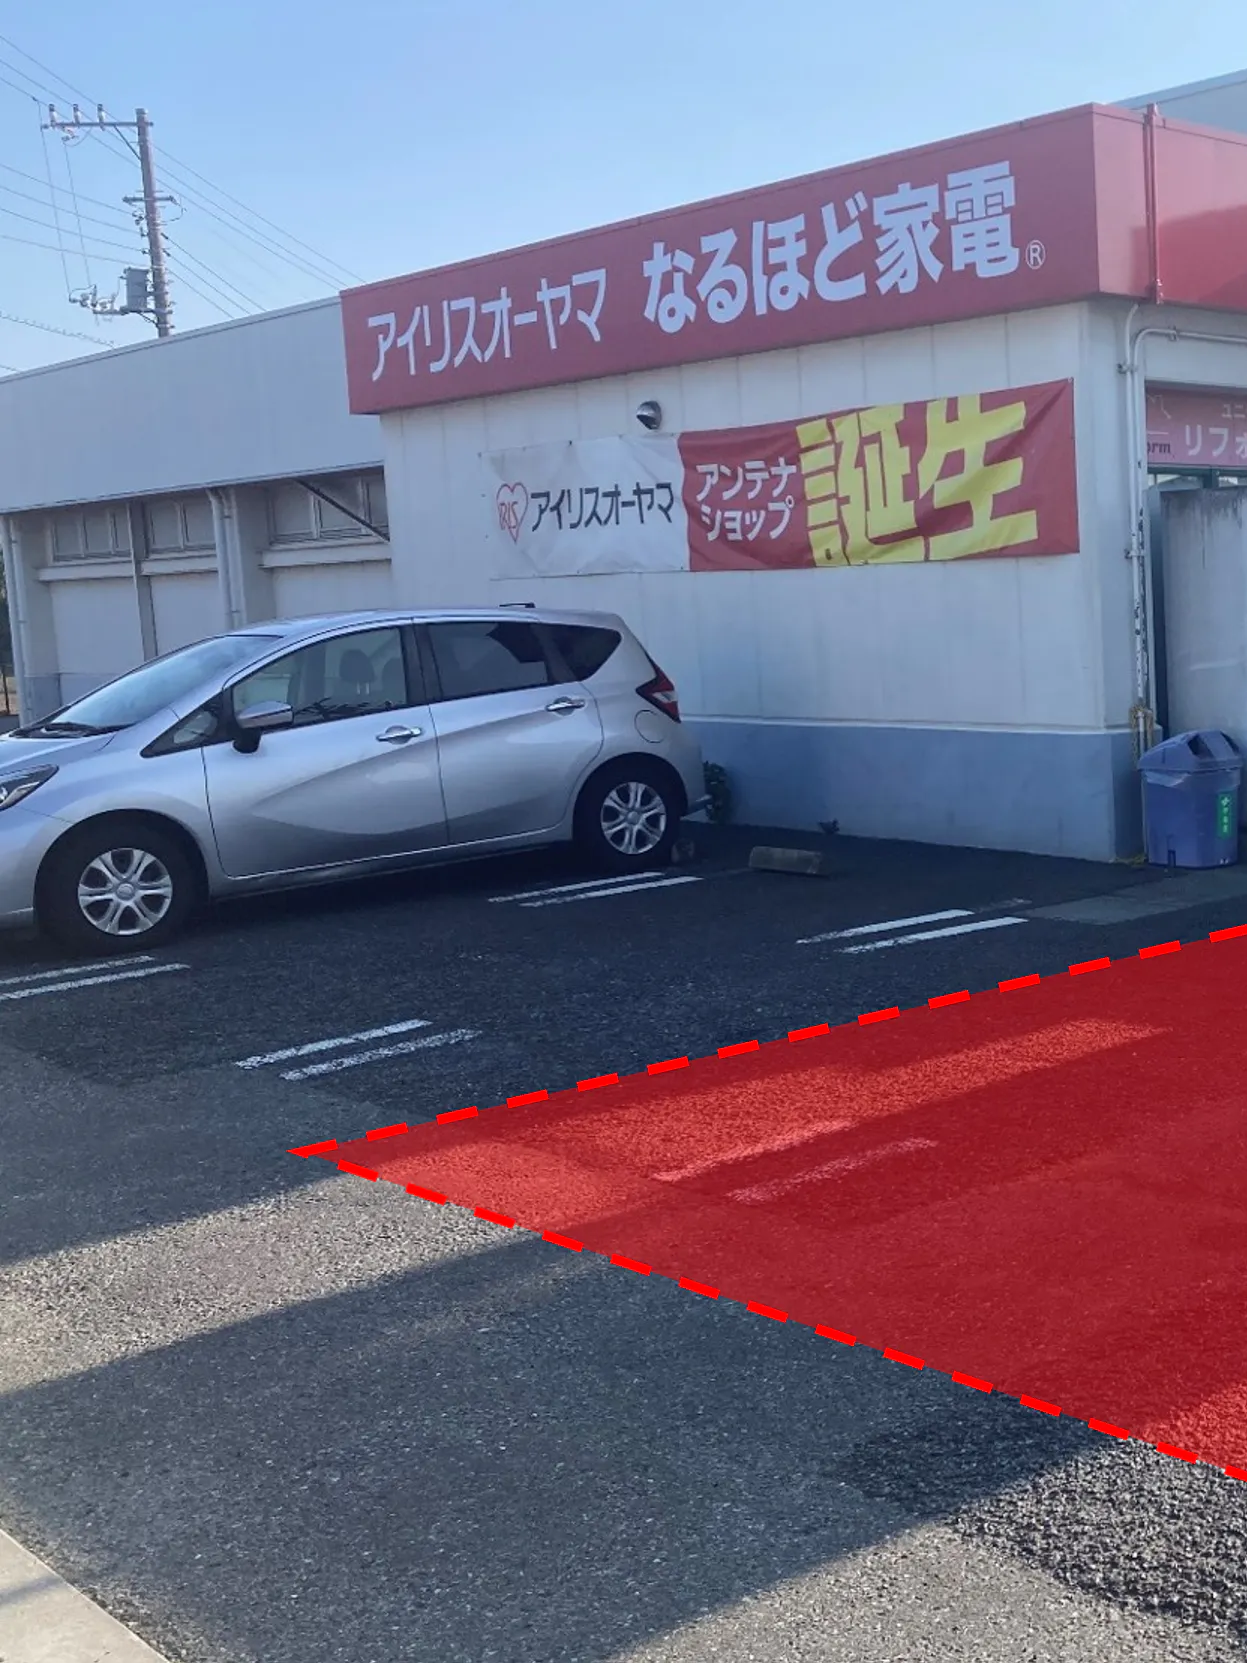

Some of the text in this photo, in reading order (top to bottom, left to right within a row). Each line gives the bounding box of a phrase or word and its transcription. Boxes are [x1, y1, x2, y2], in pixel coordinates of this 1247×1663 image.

[367, 268, 607, 382] アイリスオーヤマ
[695, 456, 797, 501] アンテナ
[796, 393, 1038, 567] 誕生
[530, 481, 675, 533] アイリスオーヤマ
[699, 494, 796, 542] ショップ
